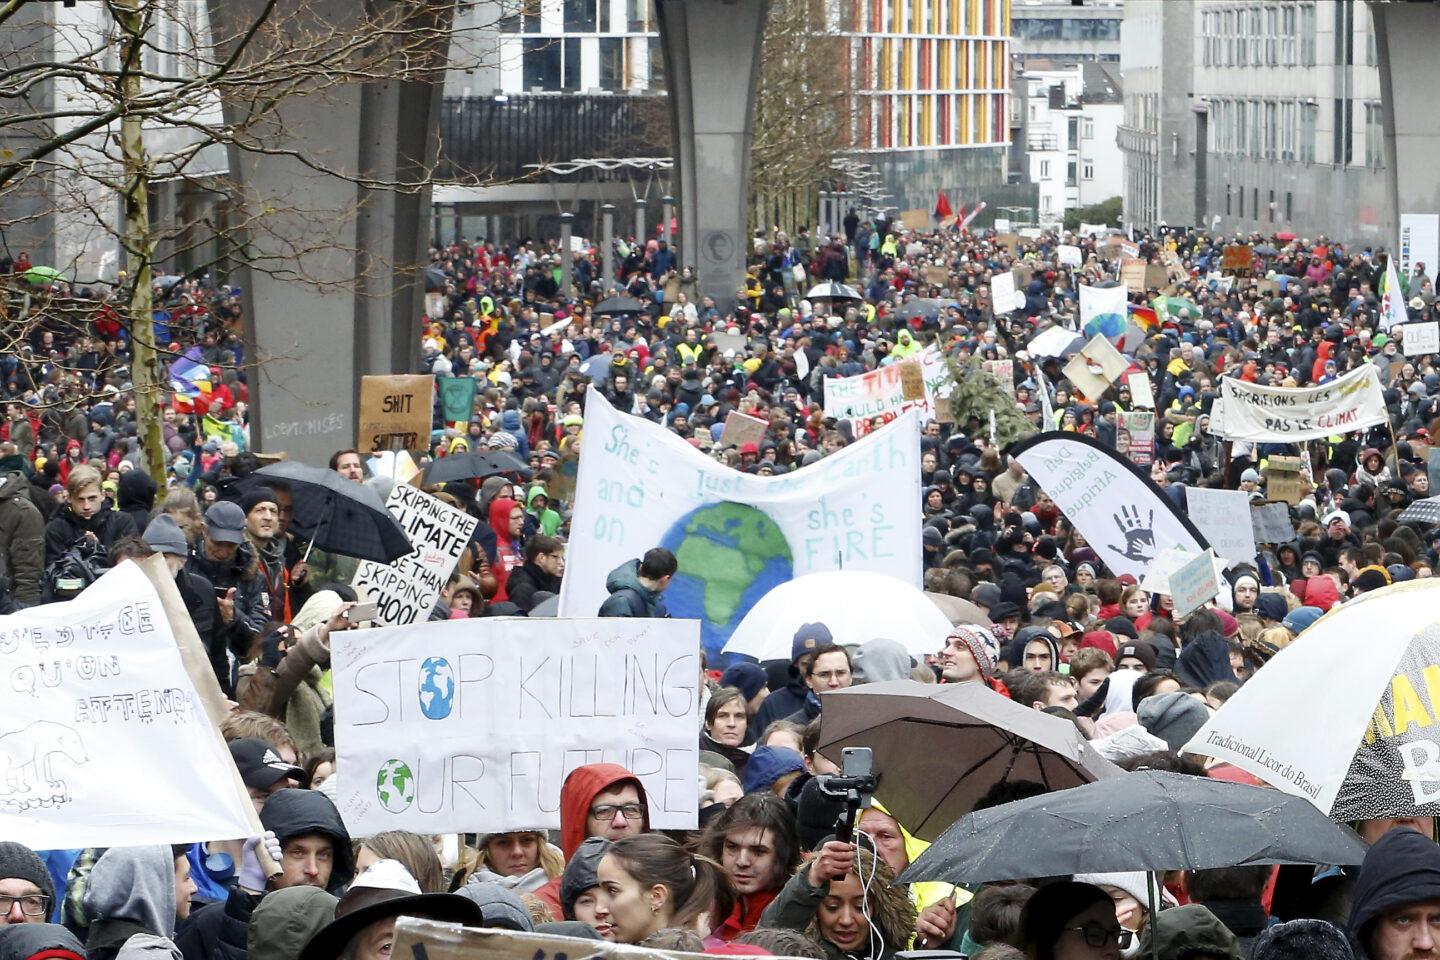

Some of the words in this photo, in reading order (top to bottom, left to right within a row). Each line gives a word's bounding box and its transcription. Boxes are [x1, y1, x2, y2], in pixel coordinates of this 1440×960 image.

[382, 394, 413, 413] SHIT
[827, 384, 856, 397] THE
[832, 400, 885, 418] WOULD
[1308, 390, 1331, 404] LES
[604, 424, 660, 475] She's
[1265, 418, 1291, 432] PAS
[448, 511, 476, 537] THE
[598, 478, 645, 508] and
[808, 492, 885, 530] she's
[594, 515, 626, 547] on
[805, 526, 895, 570] FIRE
[352, 654, 494, 726] STOP
[519, 652, 695, 719] KILLING
[377, 754, 485, 814] OUR
[1206, 730, 1260, 760] Tradicional
[1256, 749, 1283, 773] Licor
[1281, 765, 1294, 780] do
[1293, 770, 1322, 799] Brasil
